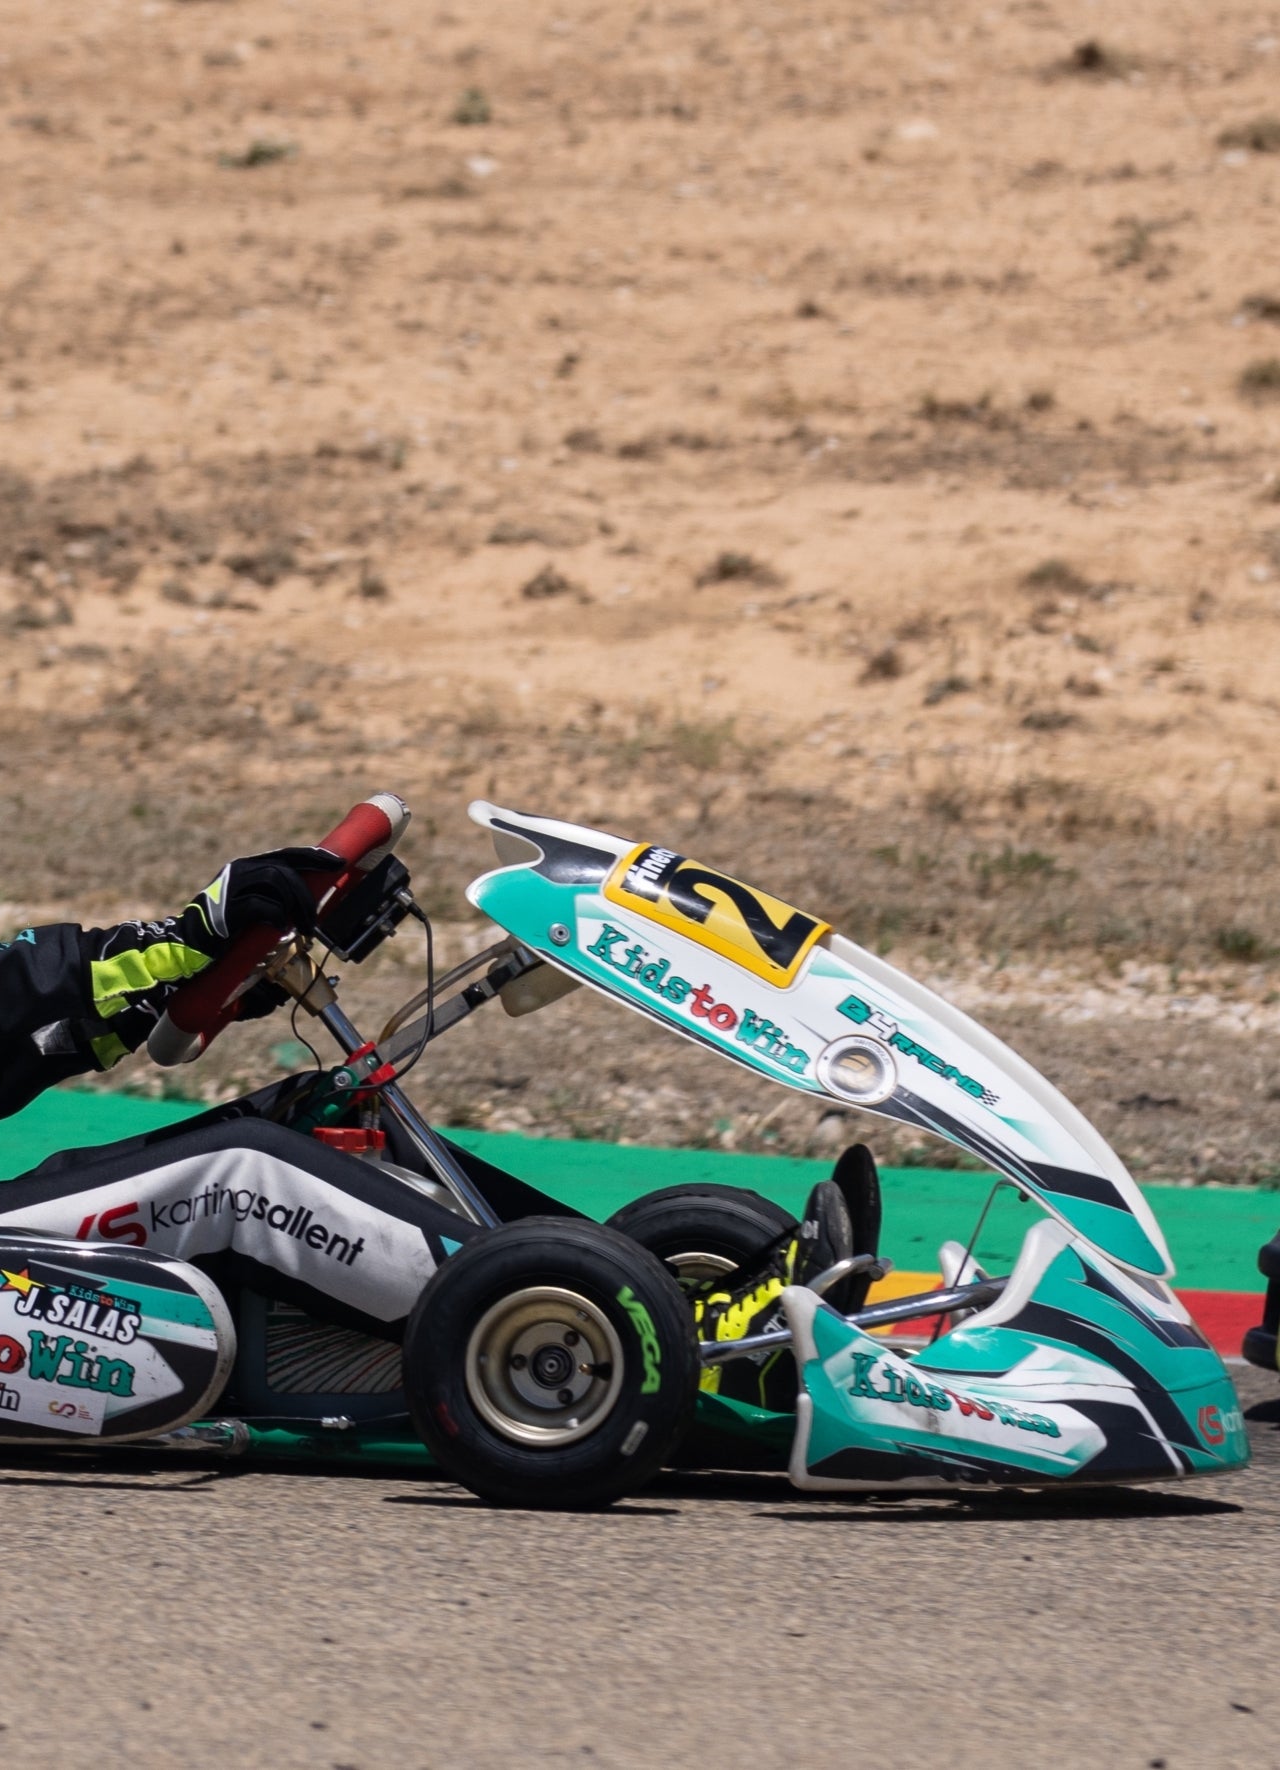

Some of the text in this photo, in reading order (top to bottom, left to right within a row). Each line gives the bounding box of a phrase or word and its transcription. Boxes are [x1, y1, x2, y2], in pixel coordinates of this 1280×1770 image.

[668, 867, 819, 970] 2
[150, 1182, 366, 1267] kartingsallent
[616, 1285, 661, 1394] VEGA
